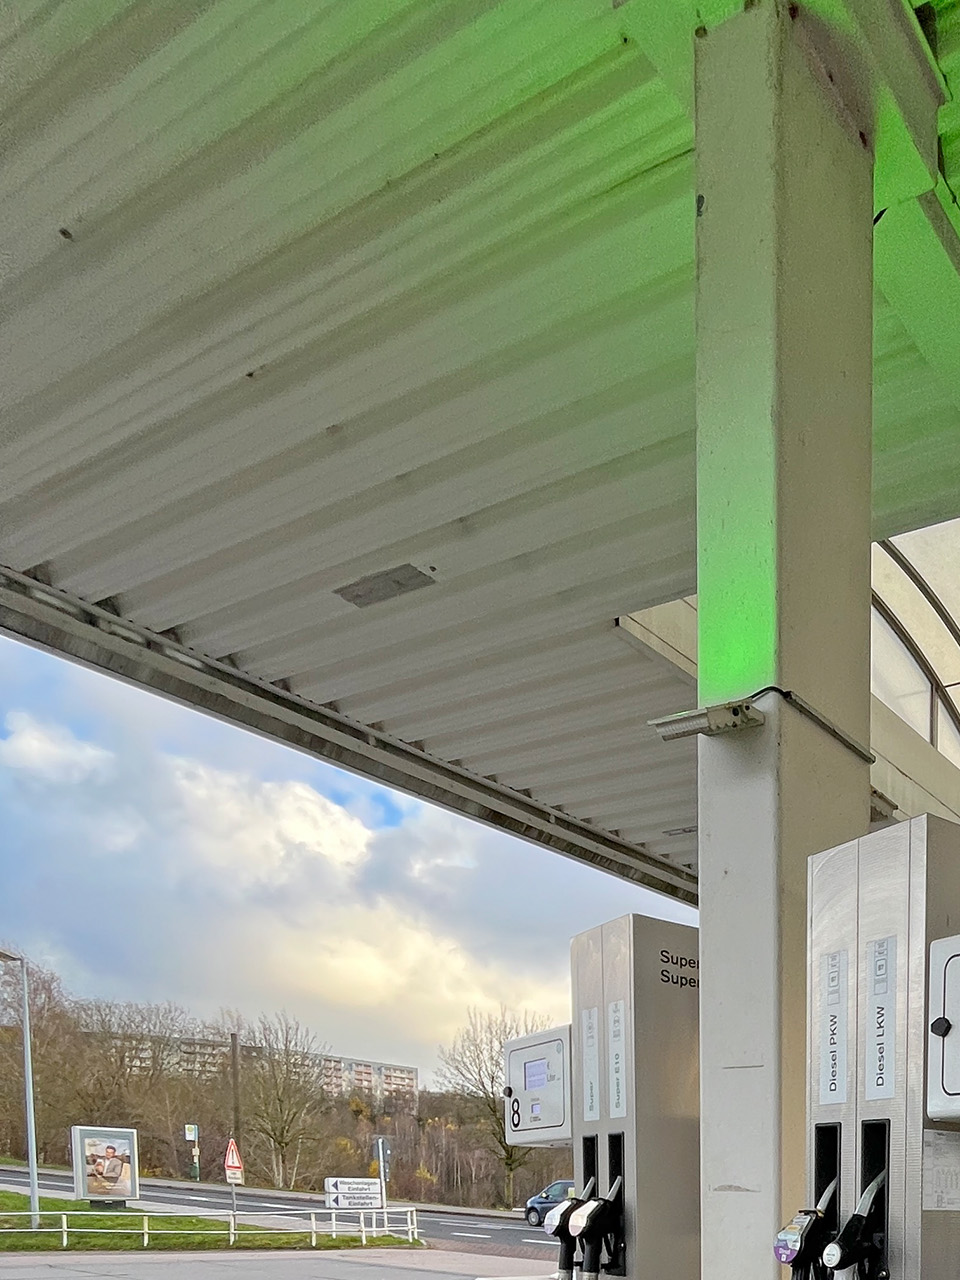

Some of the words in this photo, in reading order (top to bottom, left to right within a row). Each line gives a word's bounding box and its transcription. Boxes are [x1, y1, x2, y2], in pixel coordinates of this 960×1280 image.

[829, 1014, 838, 1046] PKW
[876, 1006, 885, 1038] LKW
[828, 1050, 838, 1092] Diesel
[875, 1042, 885, 1087] Diesel
[511, 1098, 521, 1128] 8
